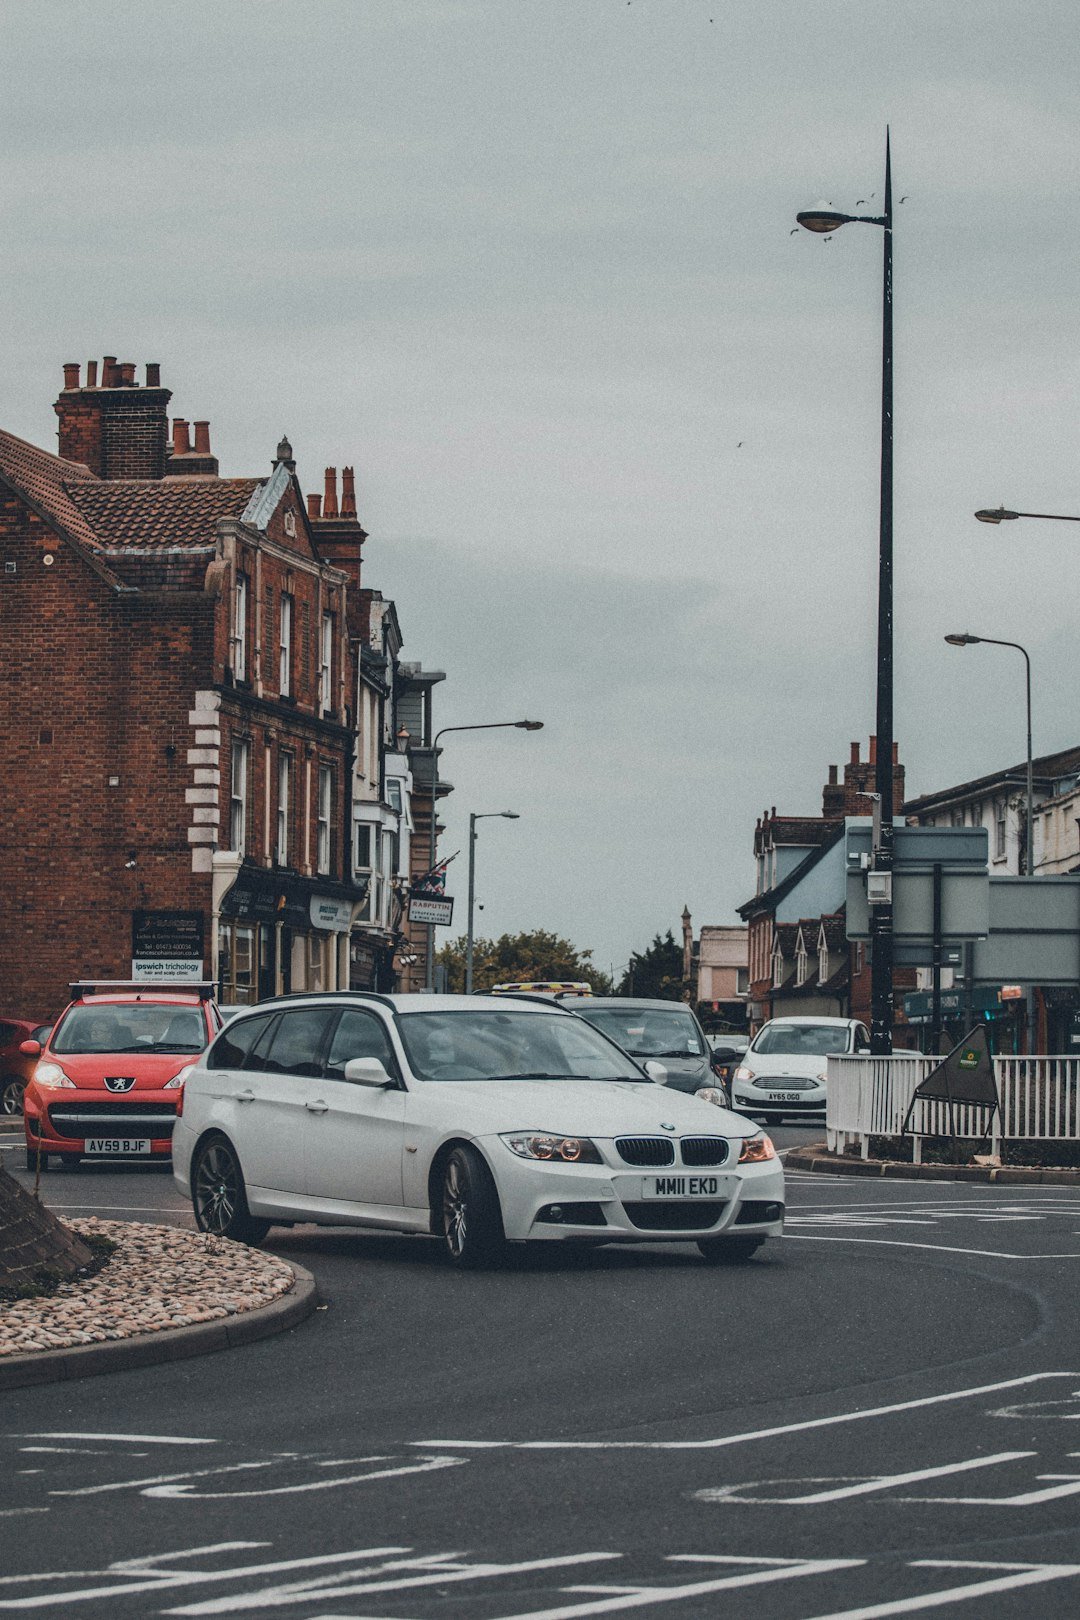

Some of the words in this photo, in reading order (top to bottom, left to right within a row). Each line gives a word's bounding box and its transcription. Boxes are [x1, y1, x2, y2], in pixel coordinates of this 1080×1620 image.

[412, 901, 450, 910] RASPUTIN
[135, 962, 164, 971] ipswich
[165, 963, 199, 972] trichology
[90, 1140, 120, 1151] AV59
[122, 1140, 146, 1152] BJF
[656, 1178, 685, 1195] MM11
[689, 1177, 718, 1194] EKD
